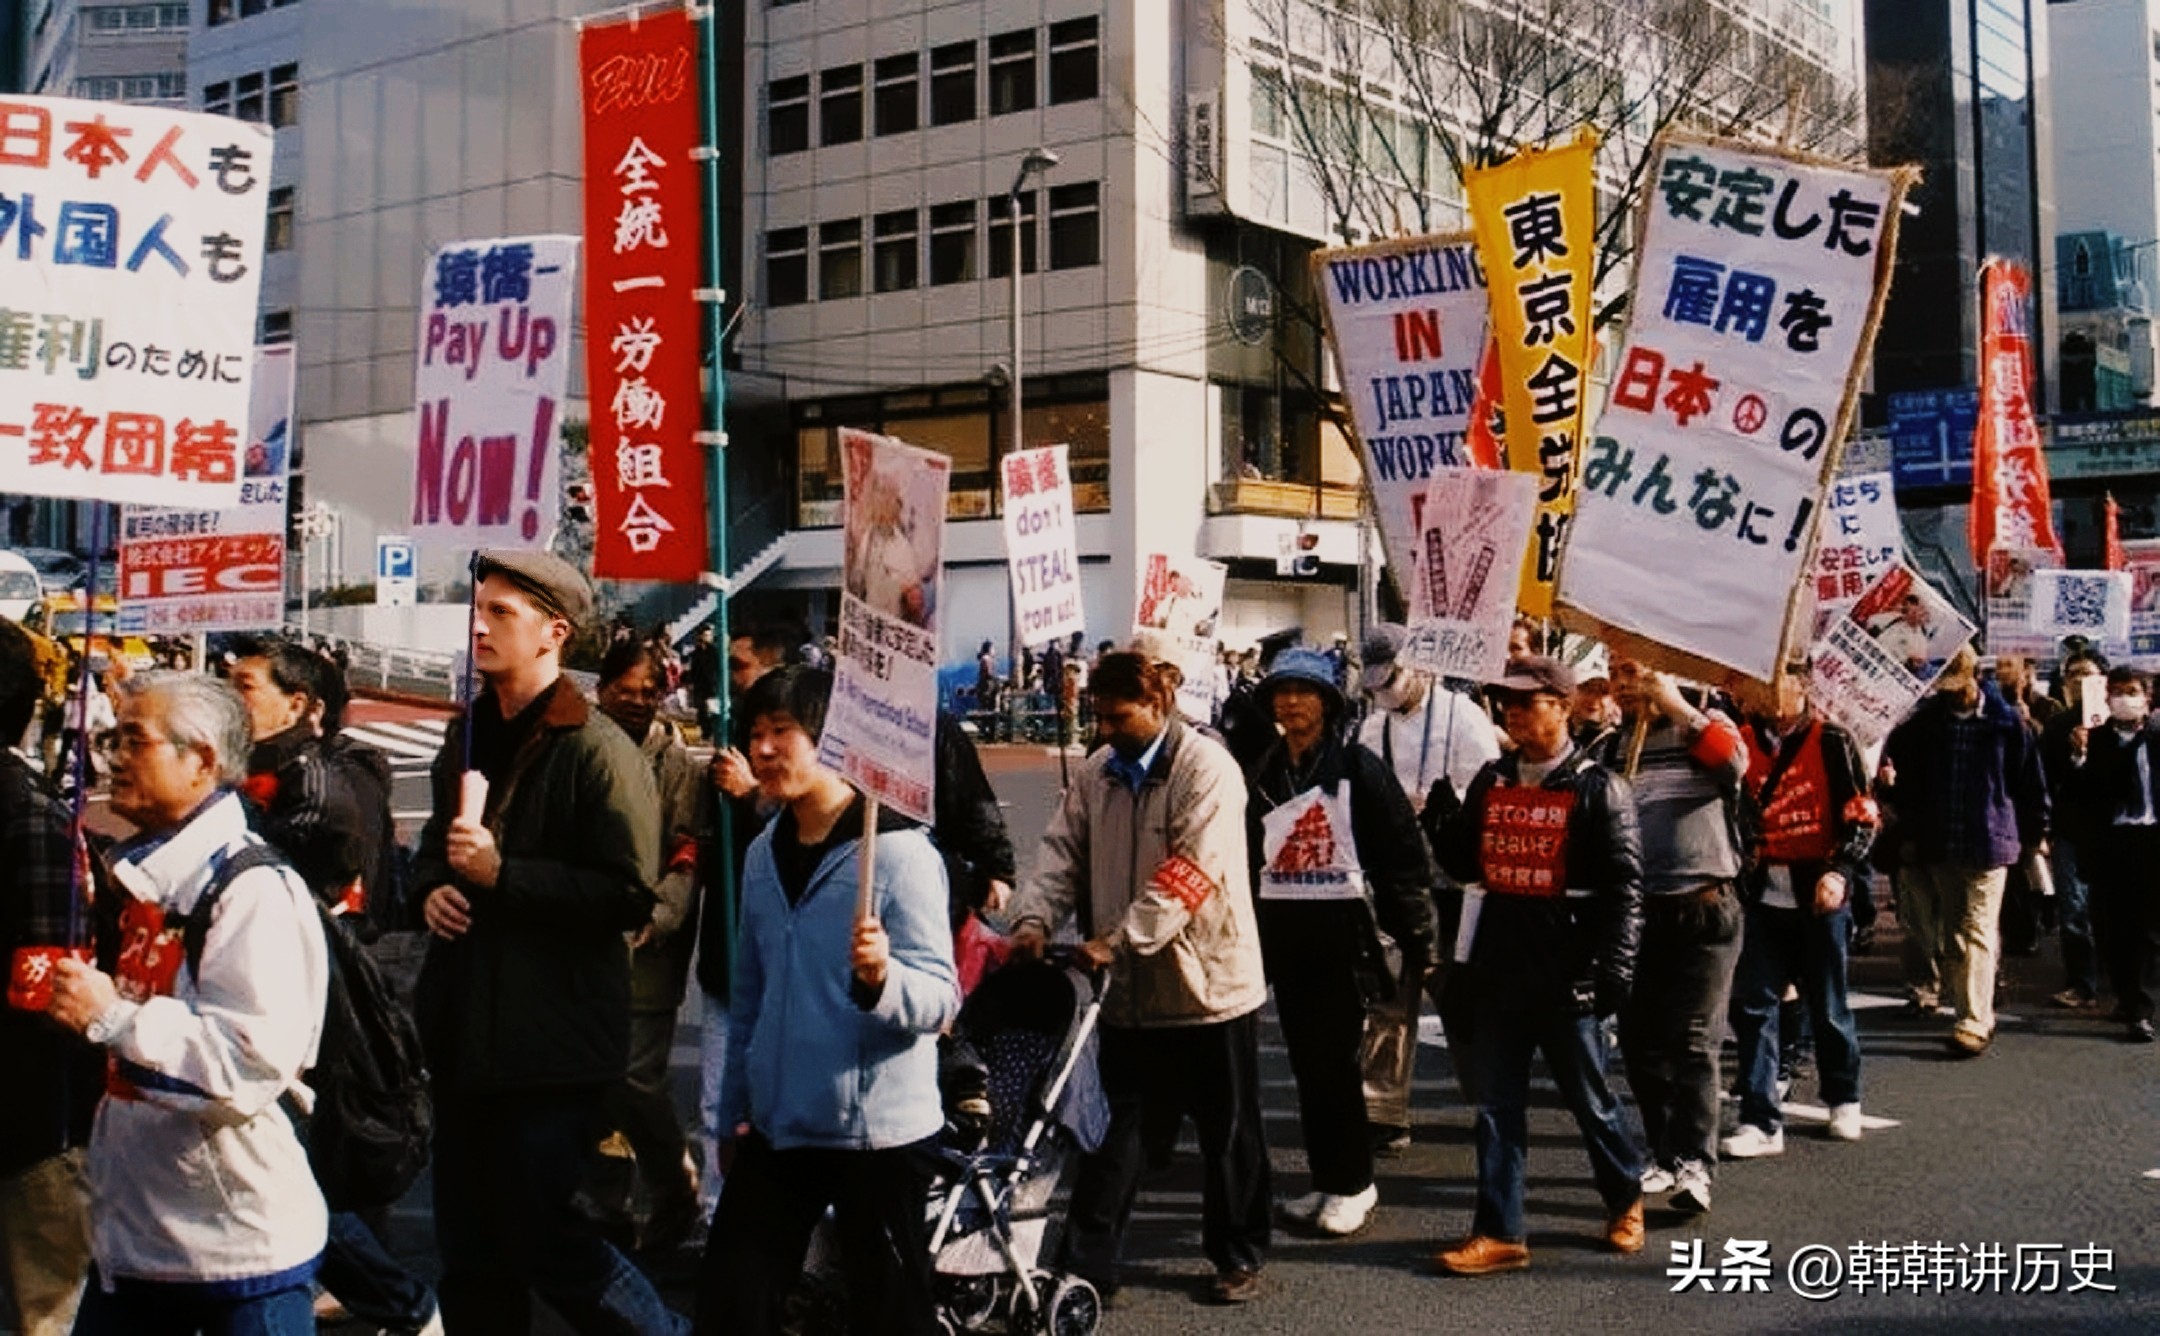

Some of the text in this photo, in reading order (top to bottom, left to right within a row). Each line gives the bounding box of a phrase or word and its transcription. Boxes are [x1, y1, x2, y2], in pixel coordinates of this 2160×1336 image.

[0, 103, 256, 195] 日本人も
[0, 192, 248, 284] 外国人も
[1660, 156, 1880, 257] 安定した
[425, 307, 556, 380] Pay Up
[610, 136, 676, 553] 全統一労働組合
[1394, 309, 1443, 361] IN
[1663, 255, 1832, 353] 雇用を
[0, 402, 239, 484] 一致団結
[1371, 370, 1475, 431] JAPAN
[413, 396, 555, 541] Now!
[1585, 437, 1814, 552] みんなに!
[128, 564, 279, 596] IEC
[385, 547, 409, 577] P
[1016, 549, 1074, 594] STEAL
